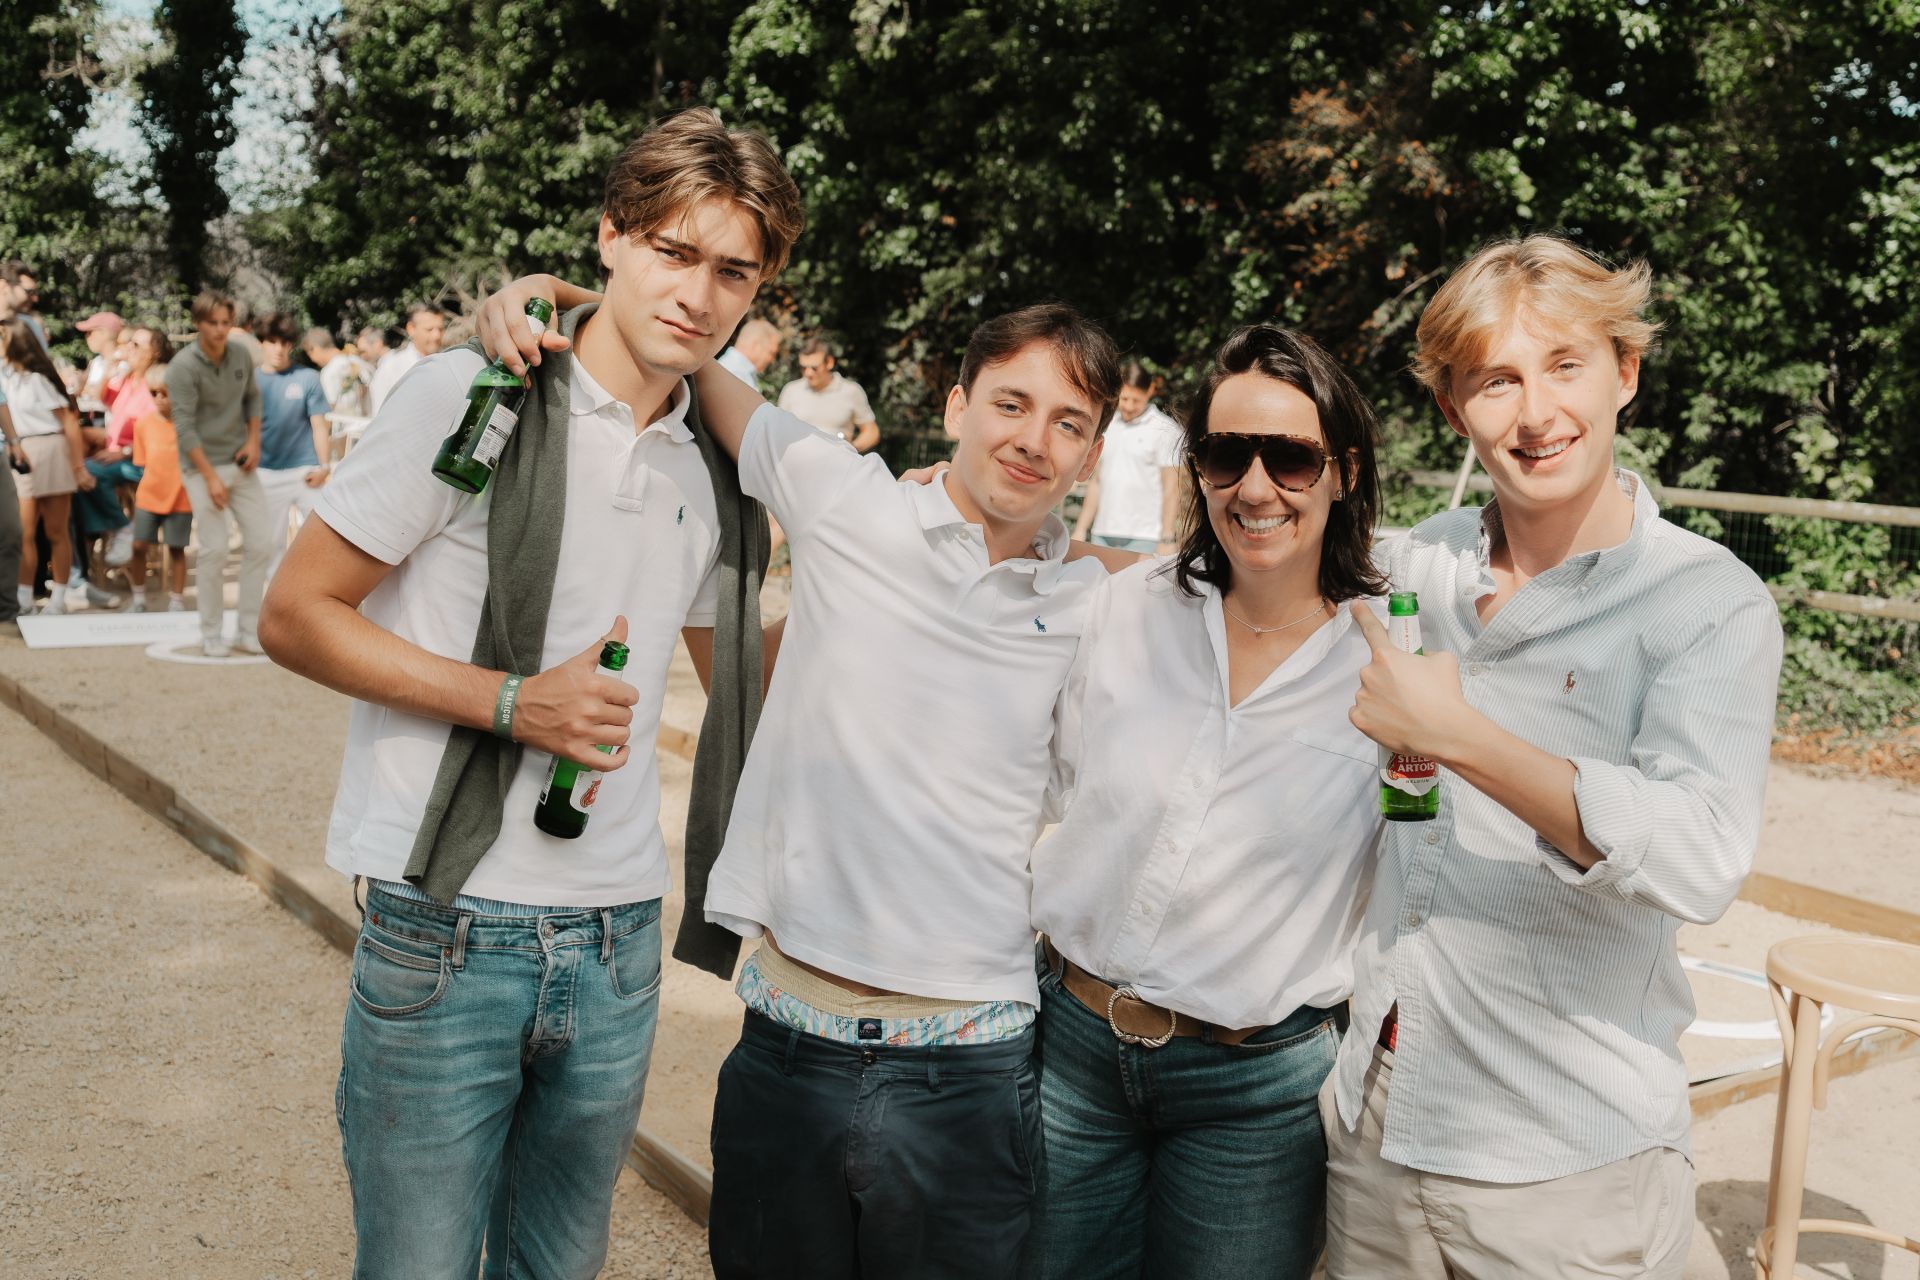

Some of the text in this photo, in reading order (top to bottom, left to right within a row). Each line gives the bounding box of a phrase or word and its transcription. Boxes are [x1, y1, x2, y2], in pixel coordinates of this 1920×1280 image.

[502, 690, 514, 724] MAXICON
[1398, 754, 1431, 763] STELL
[1398, 761, 1434, 772] ARTOIS
